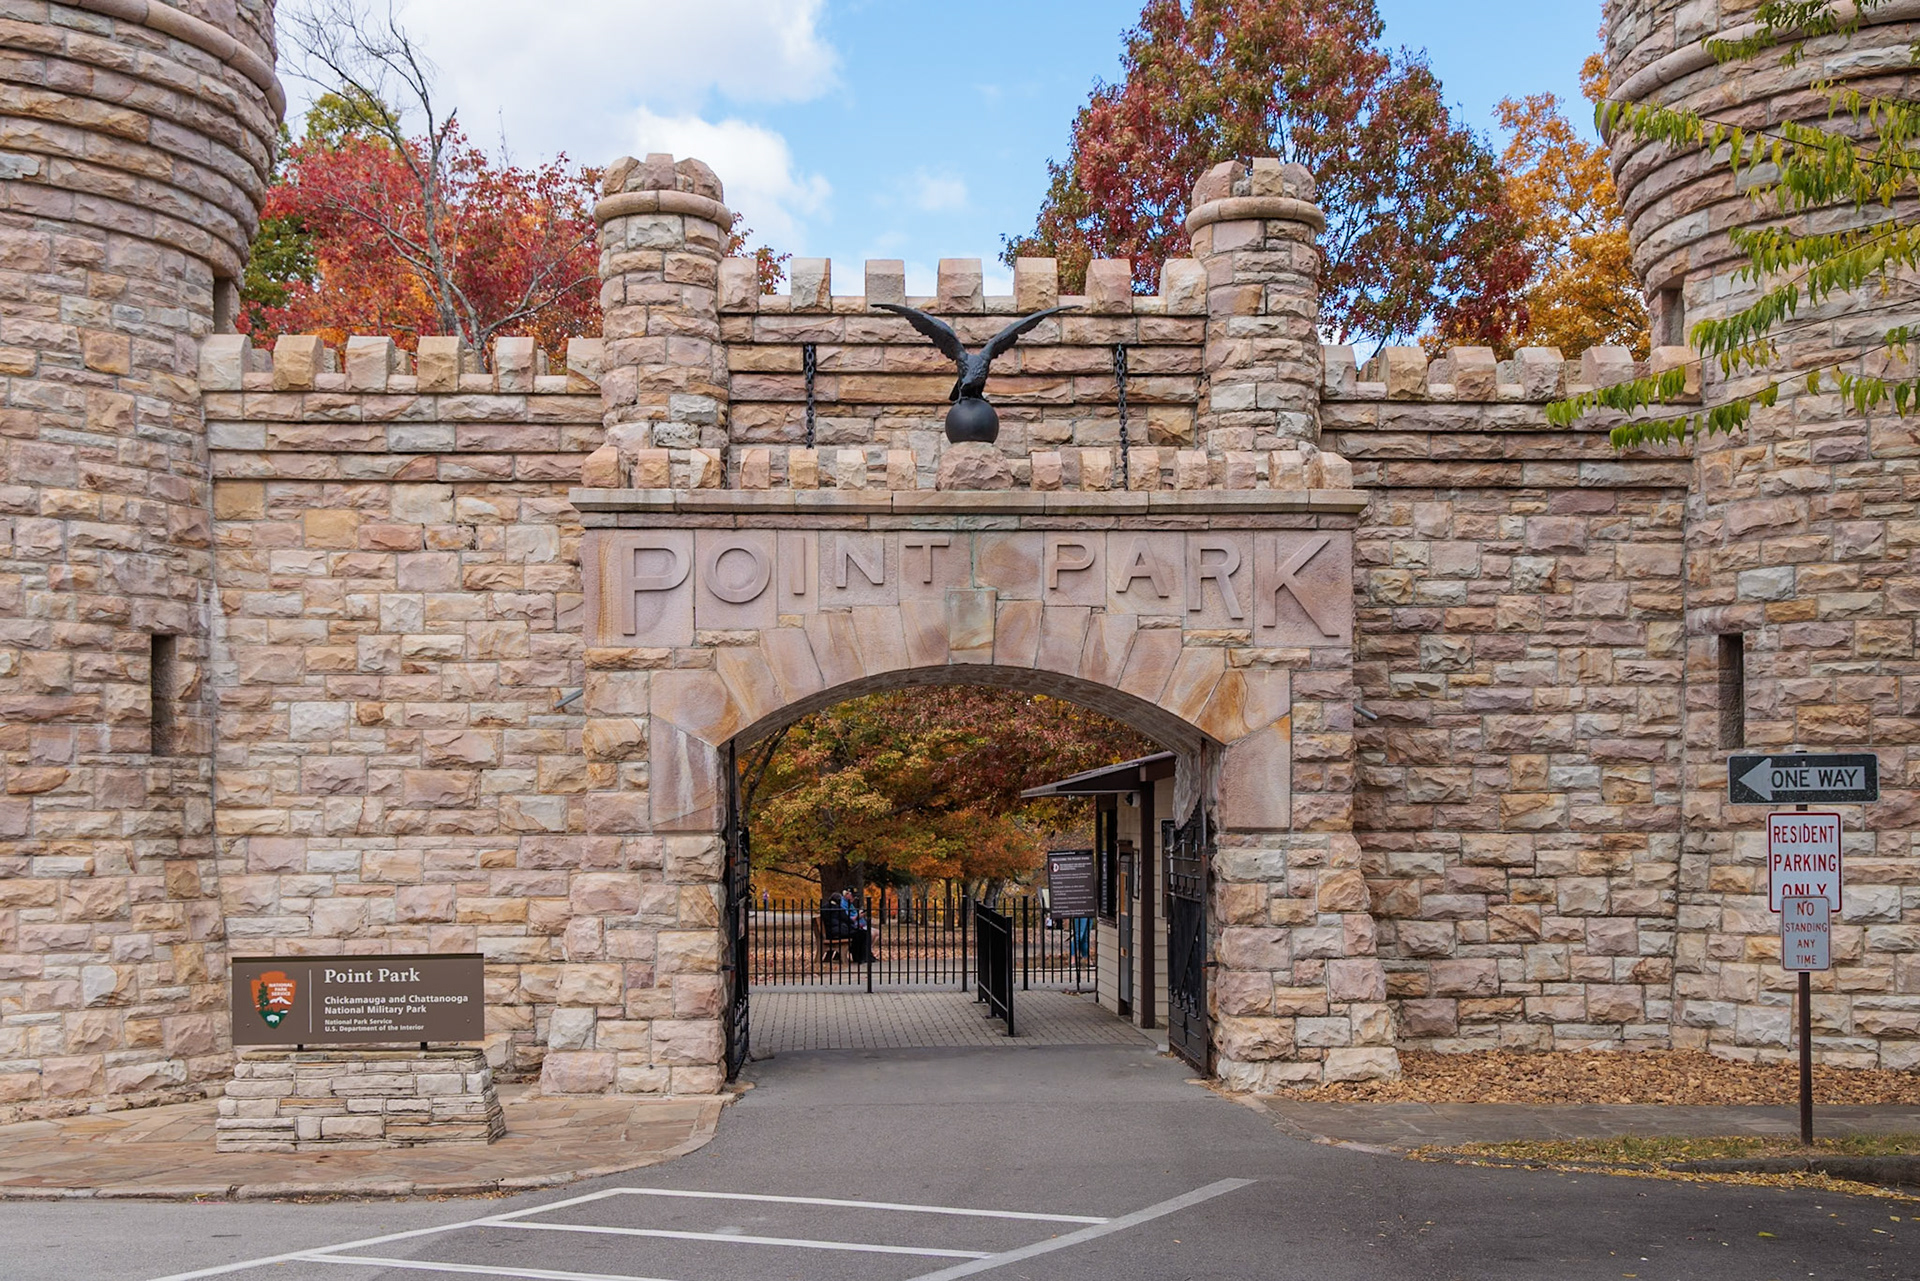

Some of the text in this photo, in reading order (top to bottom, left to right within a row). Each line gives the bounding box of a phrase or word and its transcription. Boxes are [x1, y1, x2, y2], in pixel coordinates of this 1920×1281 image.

[620, 535, 1340, 637] POINT PARK
[1771, 769, 1858, 788] ONE WAY
[1773, 825, 1835, 843] RESIDENT
[1774, 854, 1837, 872] PARKING
[1796, 902, 1815, 916] NO
[1785, 922, 1828, 932] STANDING
[1796, 939, 1815, 948] ANY
[1796, 955, 1817, 965] TIME
[324, 967, 421, 983] Point Park
[324, 995, 469, 1005] Chickamauga and Chattanooga
[324, 1005, 427, 1015] National Military Park
